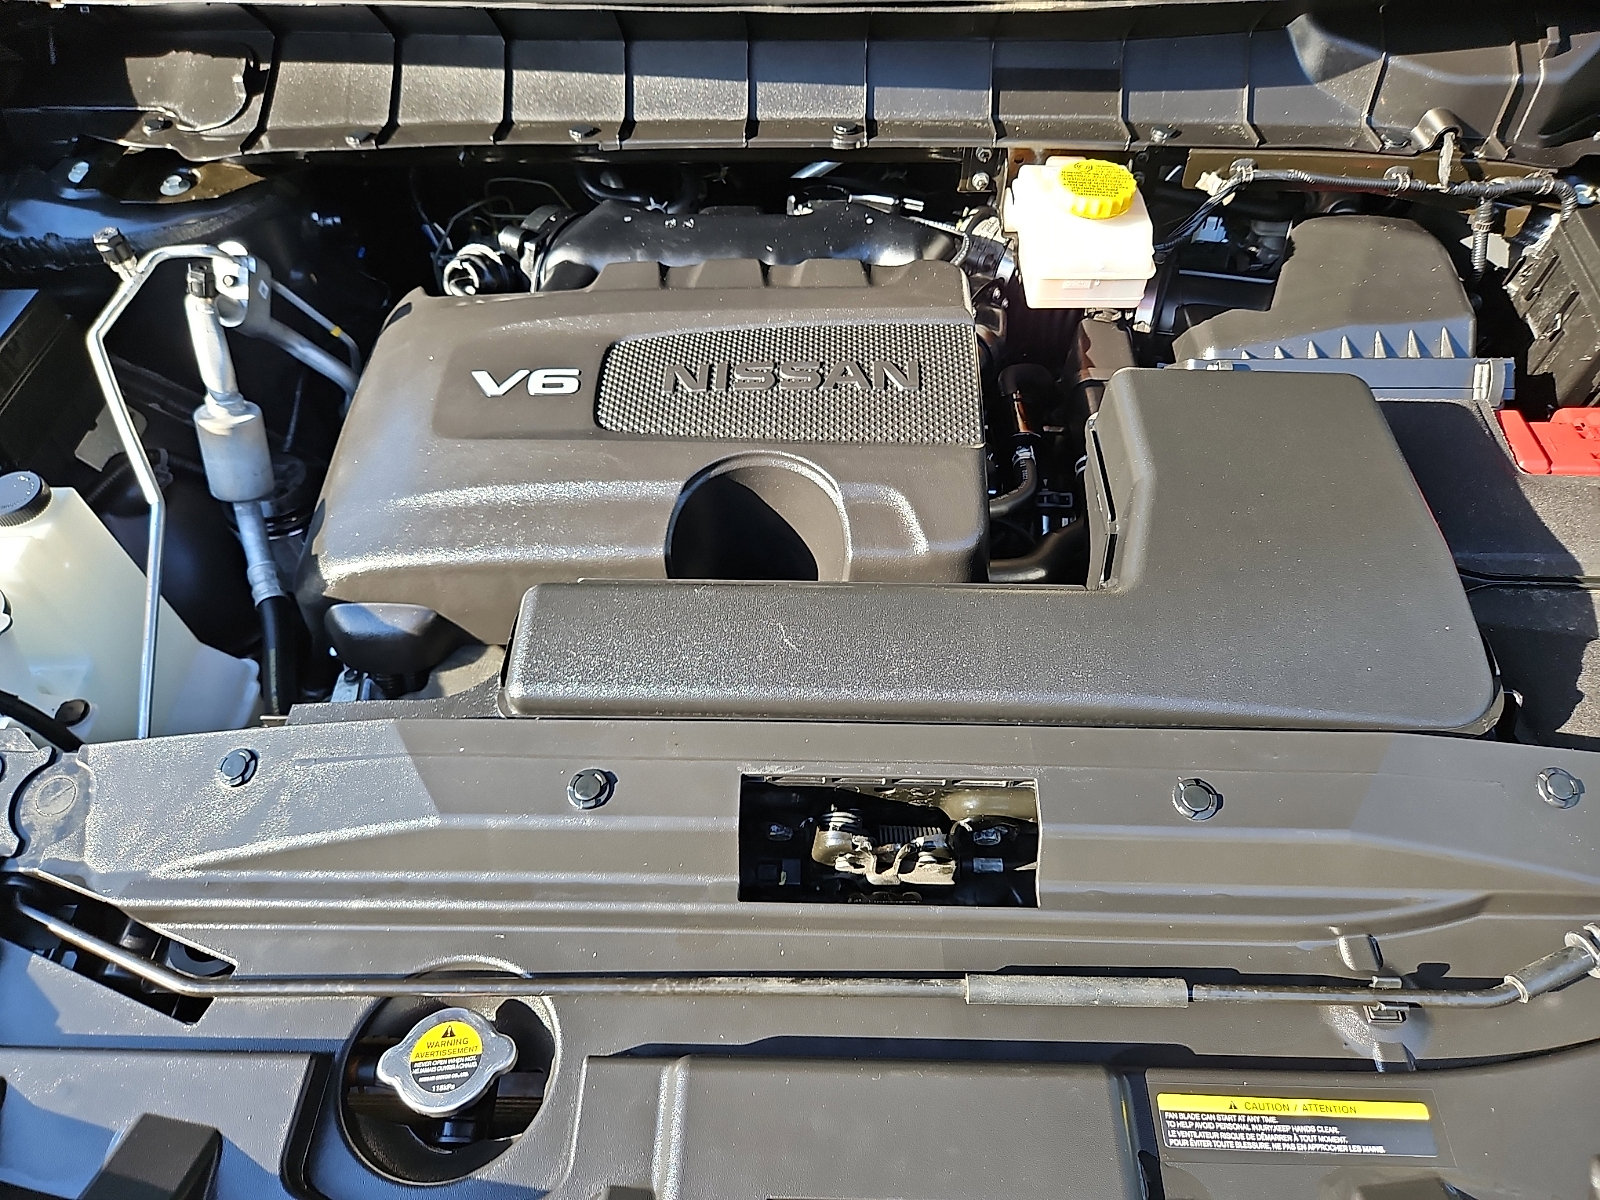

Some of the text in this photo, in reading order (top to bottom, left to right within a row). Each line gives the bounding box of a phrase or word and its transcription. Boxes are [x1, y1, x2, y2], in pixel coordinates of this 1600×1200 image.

[471, 368, 581, 397] V6
[663, 359, 921, 393] NISSAN
[427, 1037, 469, 1049] WARNING
[415, 1046, 478, 1058] AVERTISSEMENT
[414, 1060, 432, 1068] NEVER
[448, 1057, 464, 1065] WHEN
[1244, 1101, 1290, 1111] CAUTION
[1302, 1103, 1357, 1113] ATTENTION
[1164, 1112, 1178, 1120] FAN
[1179, 1112, 1200, 1120] BLADE
[1201, 1113, 1215, 1121] CAN
[1216, 1114, 1236, 1122] START
[1247, 1115, 1260, 1123] ANY
[1261, 1116, 1278, 1124] TIME.
[1166, 1120, 1176, 1128] TO
[1176, 1121, 1194, 1129] HELP
[1194, 1122, 1215, 1130] AVOID
[1215, 1122, 1251, 1131] PERSONAL
[1291, 1125, 1316, 1134] HANDS
[1316, 1125, 1340, 1134] CLEAR.
[1168, 1130, 1177, 1138] LE
[1177, 1130, 1219, 1139] VENTILATEUR
[1220, 1132, 1245, 1141] RISQUE
[1246, 1133, 1255, 1141] DE
[1256, 1132, 1292, 1142] DÉMARRER
[1299, 1134, 1317, 1143] TOUT
[1318, 1135, 1348, 1144] MOMENT.
[1169, 1138, 1189, 1147] POUR
[1190, 1138, 1212, 1148] ÉVITER
[1212, 1140, 1234, 1149] TOUTE
[1272, 1142, 1282, 1151] NE
[1282, 1143, 1296, 1151] PAS
[1296, 1143, 1307, 1151] EN
[1308, 1144, 1348, 1152] APPROCHER
[1348, 1145, 1362, 1153] LES
